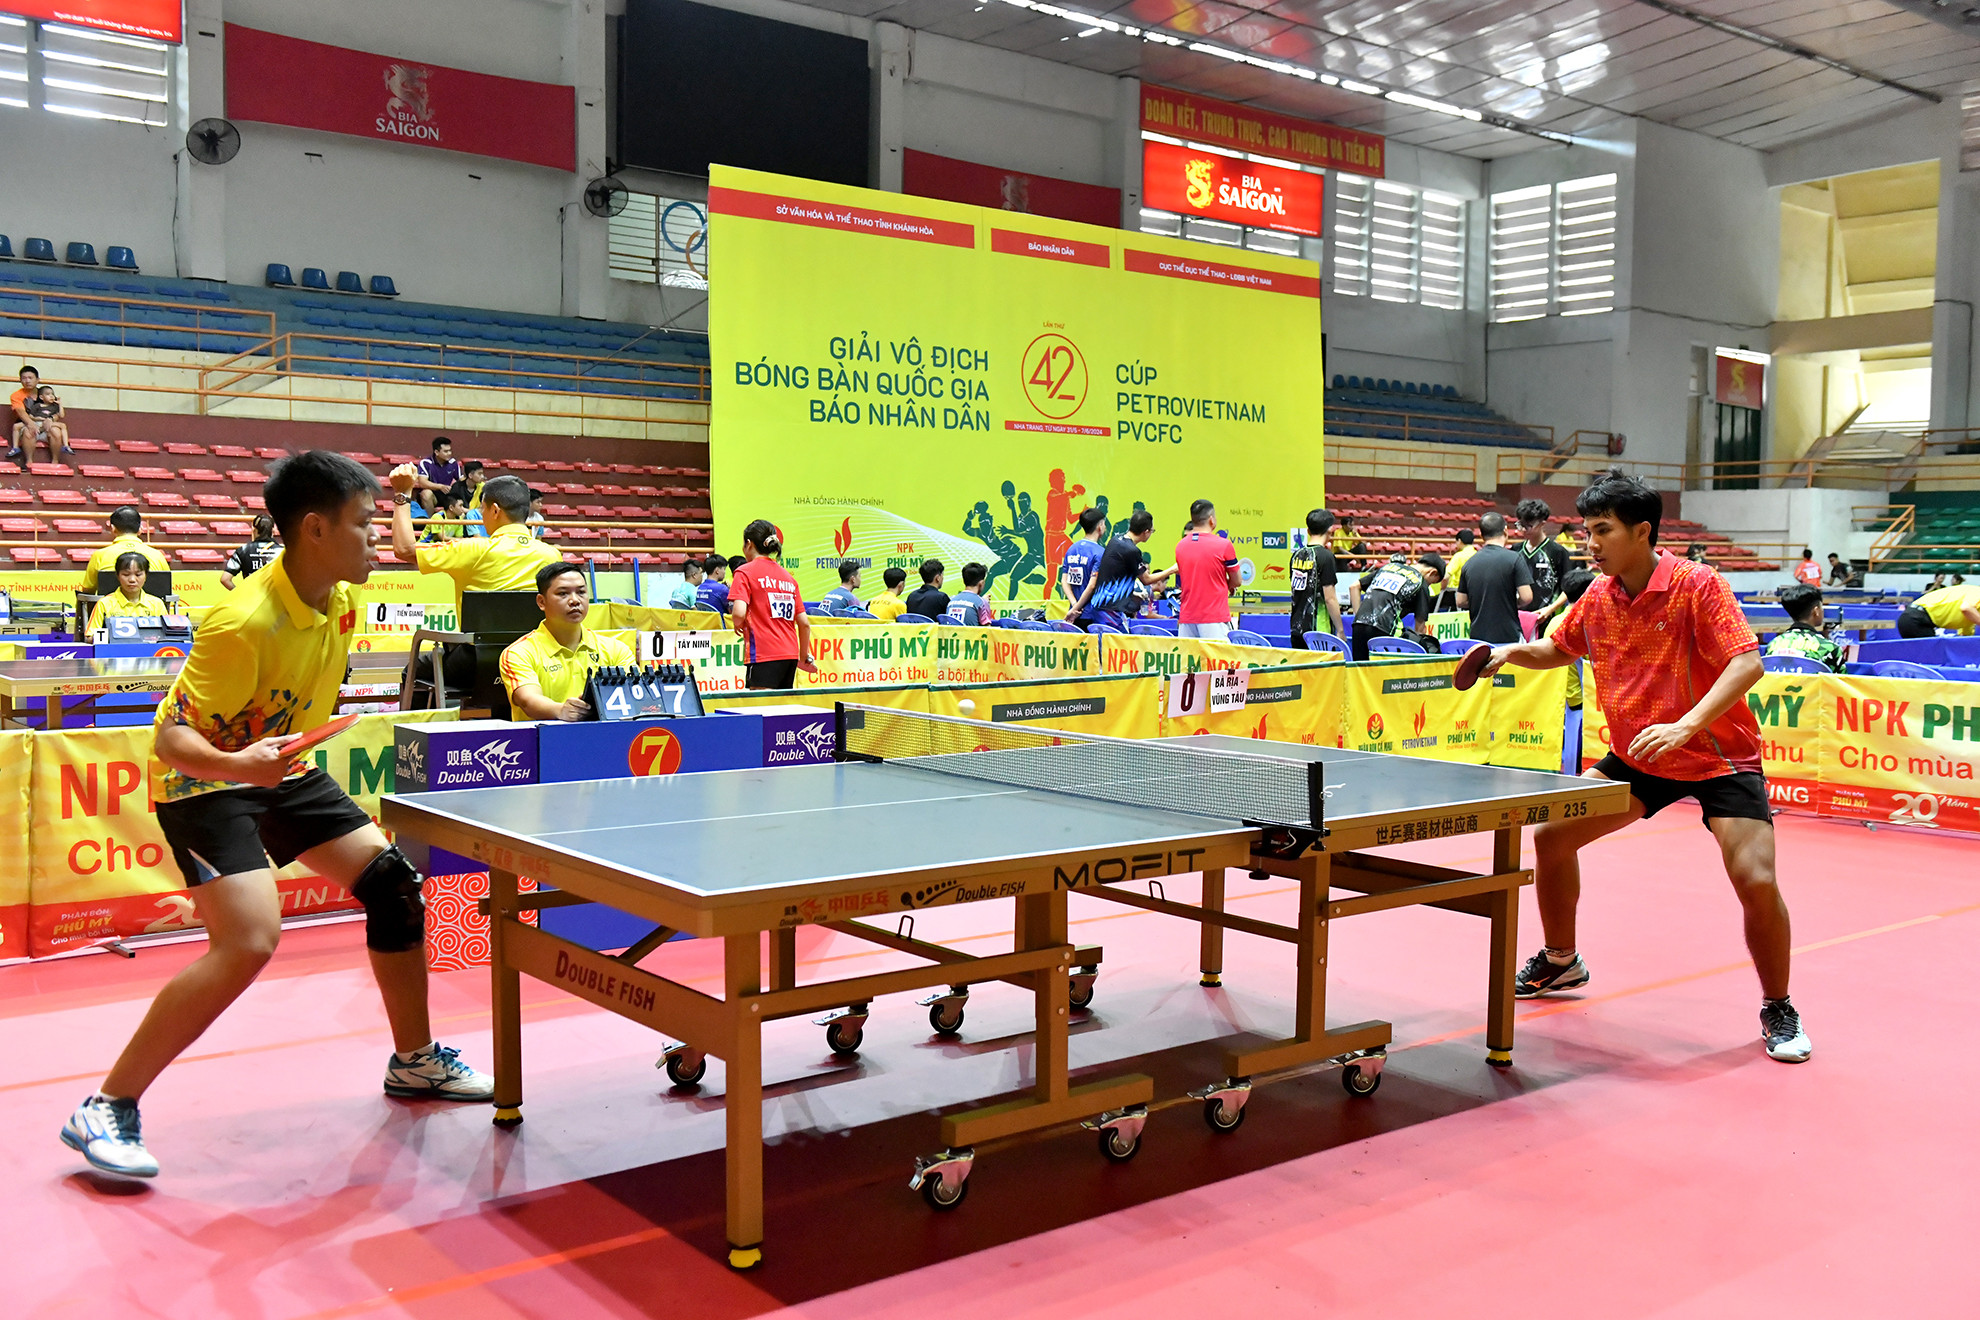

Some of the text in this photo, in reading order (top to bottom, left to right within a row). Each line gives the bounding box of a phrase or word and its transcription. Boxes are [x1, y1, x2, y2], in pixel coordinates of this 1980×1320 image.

[398, 112, 418, 123] BIA
[376, 118, 439, 141] SAIGON
[1145, 98, 1173, 125] ĐOÀN
[1202, 110, 1234, 138] TRUNG
[1268, 126, 1288, 149] CAO
[1291, 130, 1328, 159] THƯỢNG
[1330, 137, 1343, 160] VÀ
[1346, 136, 1365, 165] TIẾN
[1368, 144, 1381, 173] ĐỘ
[1242, 175, 1262, 190] BIA
[776, 204, 934, 236] SỞ VĂN HÓA VÀ THỂ THAO TỈNH KHÁNH HÒA
[1028, 242, 1075, 256] BÁO NHÂN DÂN
[1159, 263, 1172, 272] CỤC
[1173, 262, 1185, 273] THỂ
[1198, 266, 1210, 277] THỂ
[1211, 270, 1226, 279] THAO
[1246, 274, 1259, 284] VIỆT
[1259, 277, 1272, 286] NAM
[829, 331, 989, 374] GIẢI VÔ ĐỊCH
[735, 356, 990, 401] BÓNG BÀN QUỐC GIA
[1028, 345, 1076, 401] 42
[1116, 359, 1157, 386] CÚP
[810, 394, 990, 432] BÁO NHÂN DÂN
[1116, 392, 1266, 423] PETROVIETNAM
[1117, 420, 1182, 444] PVCFC
[794, 495, 884, 506] NHÀ ĐỒNG HÀNH CHÍNH
[897, 543, 914, 553] NPK
[1264, 537, 1280, 546] BIDV
[786, 558, 800, 568] MAU
[887, 555, 924, 568] PHÚ MỸ
[9, 582, 68, 592] TỈNH KHÁNH
[184, 582, 202, 591] DÂN
[377, 582, 394, 590] VIỆT
[758, 576, 776, 589] TÂY
[376, 605, 386, 622] 0
[397, 609, 408, 618] TIẾN
[772, 602, 794, 619] 138
[114, 617, 136, 637] 5
[1438, 618, 1460, 639] PHÚ
[97, 630, 105, 642] T
[678, 639, 710, 649] TÂY NINH
[652, 633, 664, 658] 0
[810, 630, 930, 661] NPK PHÚ MỸ
[994, 641, 1090, 671] NPK PHÚ MỸ
[1108, 648, 1139, 672] NPK
[1144, 647, 1181, 674] PHÚ
[808, 666, 928, 684] Cho mùa bội thu
[948, 667, 988, 682] bội thu
[1214, 675, 1238, 690] BÀ RỊA
[147, 684, 170, 692] Double
[355, 687, 374, 696] NPK
[697, 676, 728, 692] mùa
[1418, 680, 1430, 689] HÀNH
[606, 683, 686, 716] 4 0 1 7
[1181, 675, 1196, 712] 0
[1212, 692, 1244, 706] VŨNG TÀU
[1256, 690, 1292, 700] HÀNH CHÍNH
[1006, 703, 1092, 718] NHÀ ĐỒNG HÀNH CHÍNH
[1748, 686, 1805, 728] MỸ
[1455, 720, 1469, 730] NPK
[1518, 720, 1535, 730] NPK
[1836, 696, 1910, 737] NPK
[1302, 734, 1315, 744] NPK
[1402, 736, 1438, 750] PETROVIETNAM
[1448, 730, 1476, 744] PHÚ MỸ
[1509, 732, 1544, 744] PHÚ MỸ
[641, 734, 670, 776] 7
[768, 749, 805, 762] Double
[1761, 740, 1804, 763] thu
[1839, 746, 1973, 780] Cho mùa
[396, 763, 427, 784] Double FISH
[437, 768, 531, 784] Double FISH
[1564, 802, 1588, 818] 235
[1832, 796, 1868, 808] PHÚ MỸ
[1888, 793, 1969, 823] 20 Năm
[1525, 805, 1550, 825] 双鱼
[1376, 814, 1478, 845] 世乒赛器材供应商
[68, 837, 164, 875] Cho
[1054, 848, 1206, 890] MOFIT
[955, 881, 1026, 903] Double FISH
[828, 890, 889, 914] 中国乒乓
[61, 908, 110, 921] PHÂN BÓN
[53, 914, 113, 935] PHÚ MỸ
[51, 936, 68, 945] Cho
[70, 932, 86, 942] mùa
[102, 926, 114, 935] thu
[555, 950, 656, 1012] DOUBLE FISH
